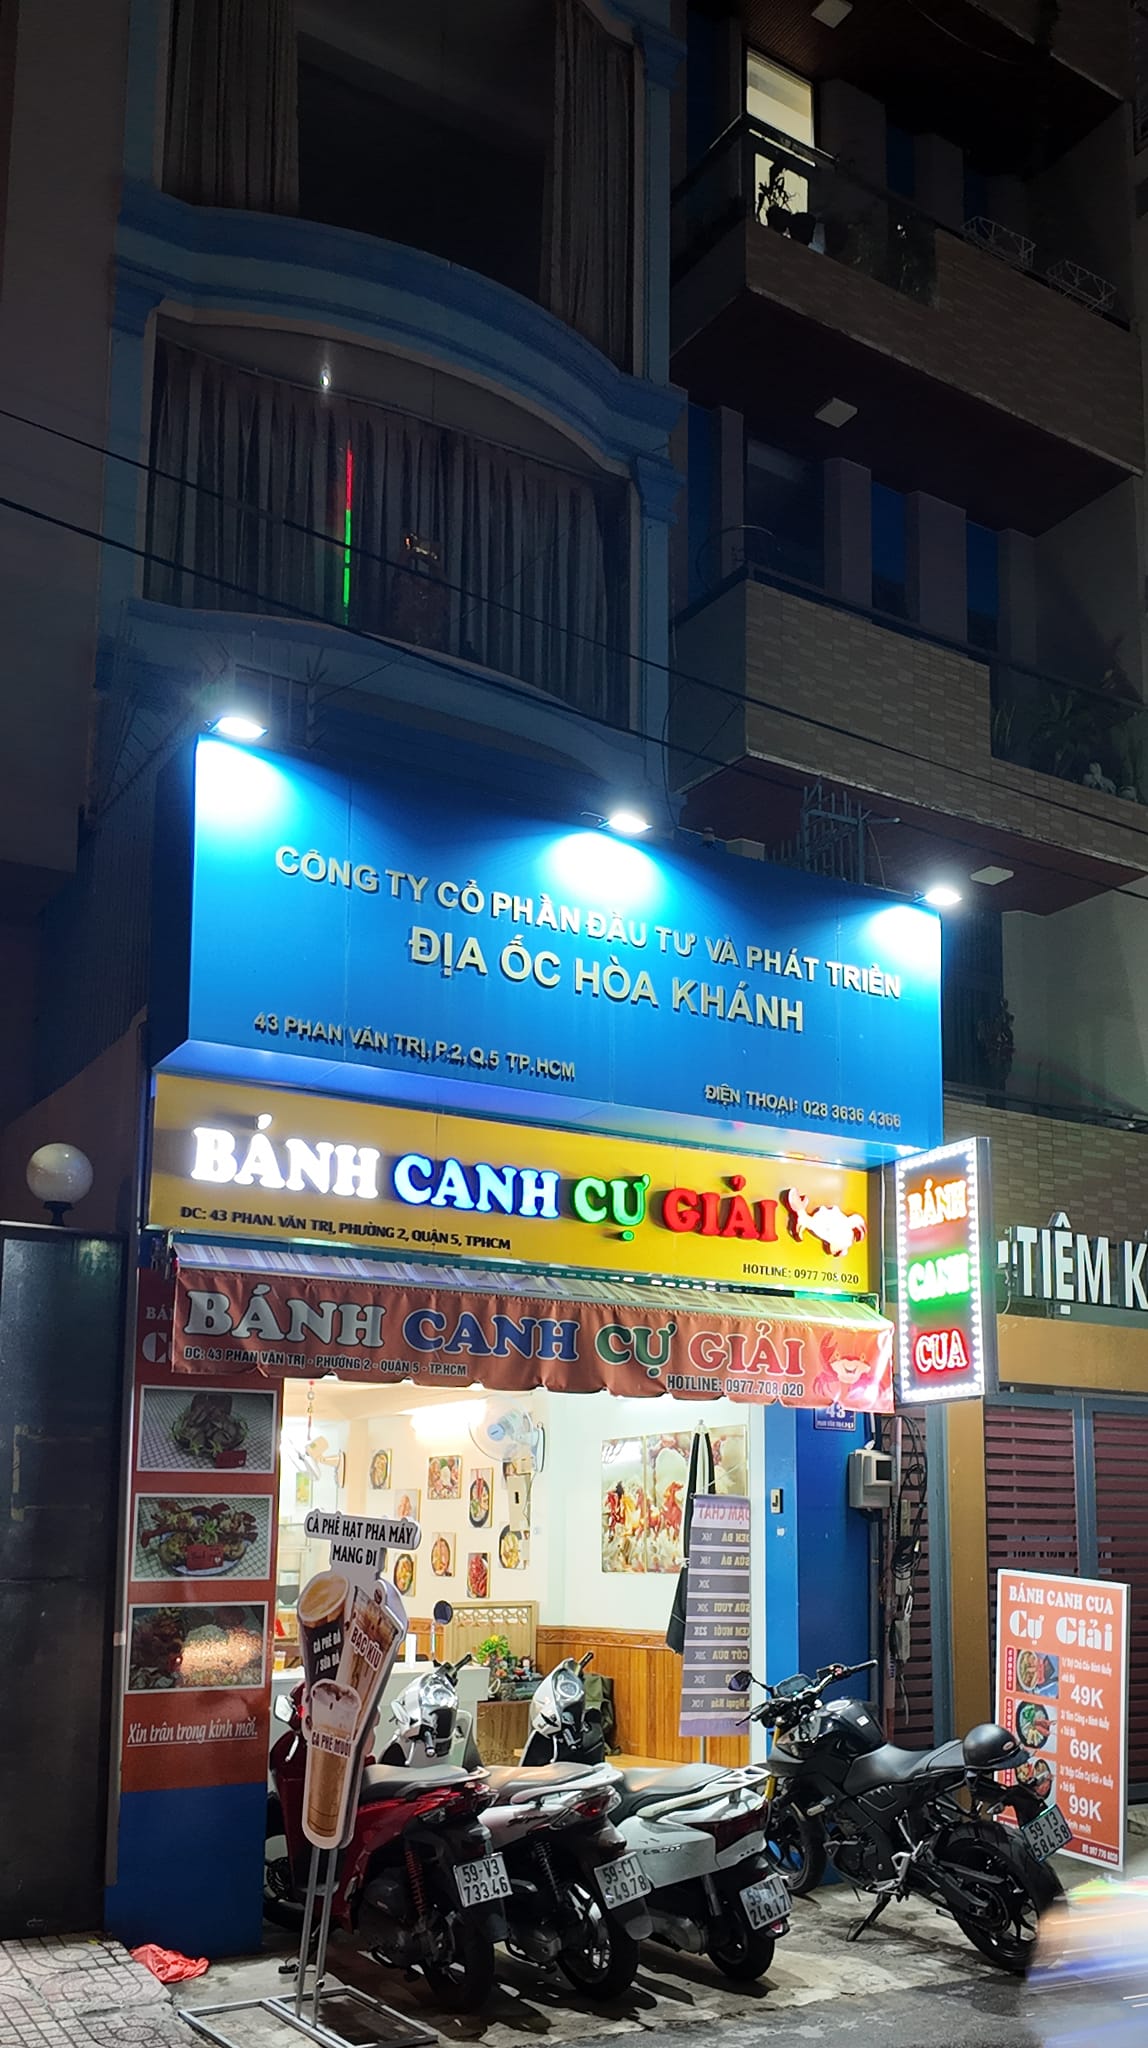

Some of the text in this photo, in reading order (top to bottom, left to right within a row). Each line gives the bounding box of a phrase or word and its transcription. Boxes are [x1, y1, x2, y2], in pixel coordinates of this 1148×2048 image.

[275, 846, 901, 999] CÔNG TY CỔ PHẦN ĐẦU TƯ VÀ PHÁT TRIỂN
[408, 925, 804, 1032] ĐỊA ỐC HÒA KHÁNH
[254, 1012, 279, 1031] 43
[284, 1016, 343, 1042] PHAN
[349, 1026, 389, 1051] VĂN
[506, 1052, 576, 1079] TP.HCM
[704, 1083, 901, 1128] ĐIỆN THOẠI: 028 3636 4366
[191, 1113, 778, 1242] BÁNH CANH CỰ GIẢI
[906, 1178, 968, 1230] BÁNH
[210, 1209, 227, 1221] 43
[278, 1215, 307, 1230] VĂN
[397, 1228, 410, 1242] 2,
[411, 1227, 449, 1246] QUẬN
[450, 1234, 462, 1247] 5,
[465, 1235, 512, 1250] TPHCM
[743, 1263, 792, 1279] HOTLINE:
[794, 1268, 818, 1281] 0977
[840, 1273, 859, 1284] 020
[907, 1253, 970, 1302] CANH
[183, 1283, 806, 1378] BÁNH CANH CỰ GIẢI
[207, 1347, 222, 1361] 43
[225, 1348, 258, 1363] PHAN
[287, 1353, 306, 1368] TRỊ
[363, 1359, 371, 1370] 2
[380, 1358, 410, 1375] QUẬN
[412, 1361, 420, 1373] 5
[429, 1363, 467, 1376] TP.HCM
[915, 1329, 968, 1373] CUA
[667, 1374, 804, 1397] HOTLINE: 0977.708.020
[826, 1402, 846, 1418] 43
[306, 1513, 413, 1544] CÀ PHÊ HẠT PHA MÁY
[332, 1544, 377, 1566] MANG ĐI
[1009, 1582, 1114, 1615] BÁNH CANH CUA
[1009, 1610, 1113, 1652] Cự Giải
[1070, 1684, 1103, 1709] 49K
[127, 1722, 147, 1744] Xin
[150, 1721, 174, 1741] trân
[177, 1722, 206, 1745] trọng
[209, 1717, 233, 1738] kính
[1069, 1738, 1103, 1764] 69K
[1068, 1794, 1102, 1822] 99K
[1032, 1825, 1068, 1858] 584.58
[462, 1860, 500, 1882] 59-V3
[602, 1859, 637, 1885] 59-C1
[463, 1879, 508, 1902] 733.46
[750, 1895, 787, 1927] 248.17
